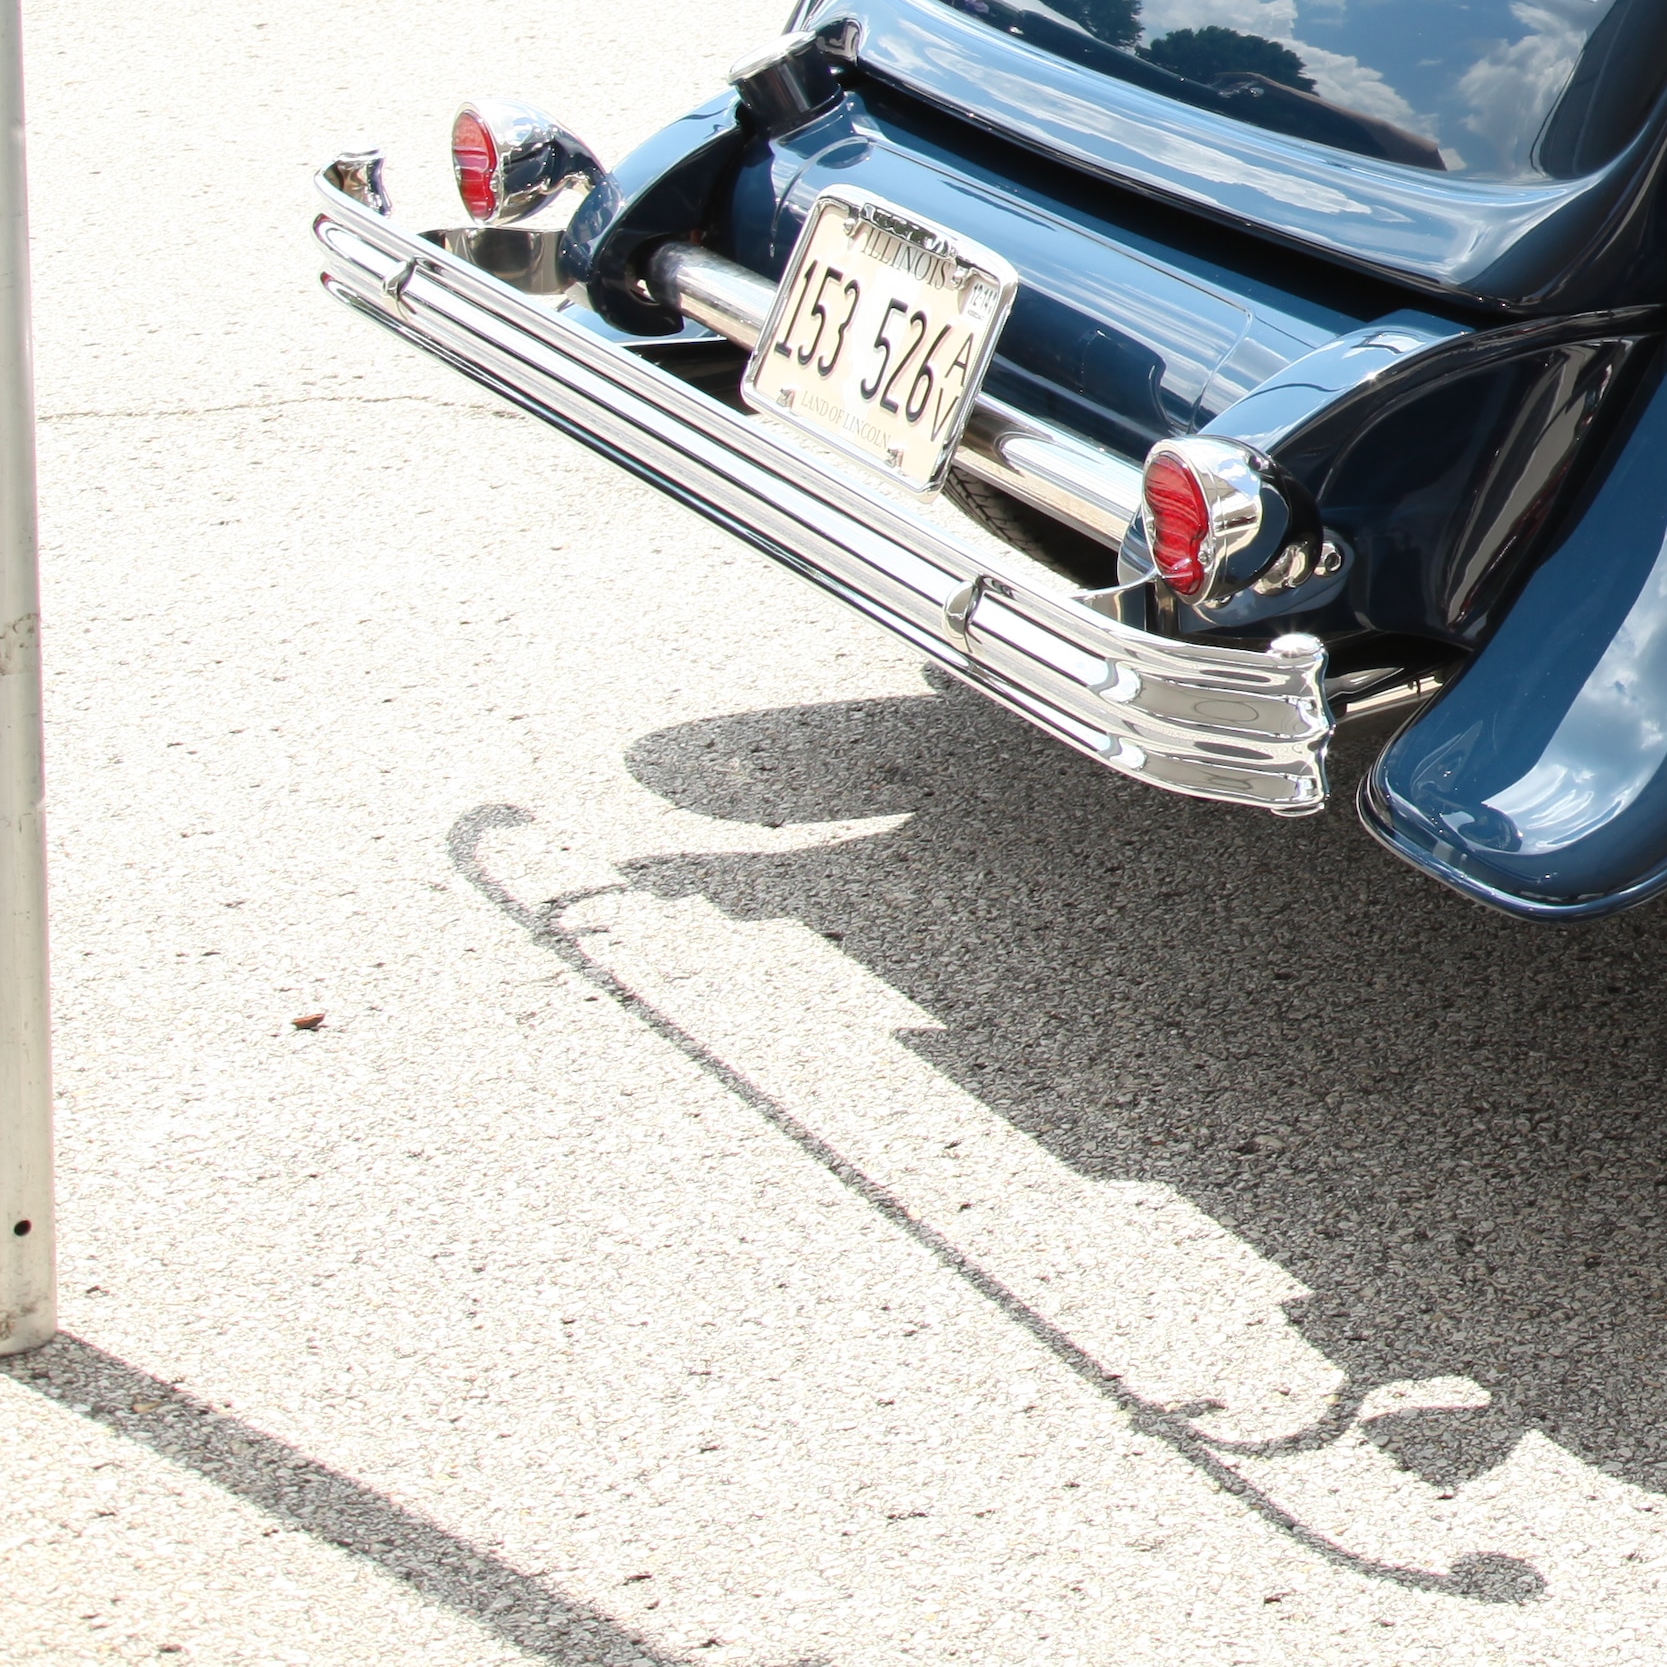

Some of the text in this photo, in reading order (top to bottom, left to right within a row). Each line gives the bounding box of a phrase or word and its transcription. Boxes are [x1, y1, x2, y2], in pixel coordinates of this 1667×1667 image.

[861, 226, 950, 291] ILLINOIS
[773, 258, 953, 424] 153 526
[800, 389, 893, 451] LAND OF LINCOLN
